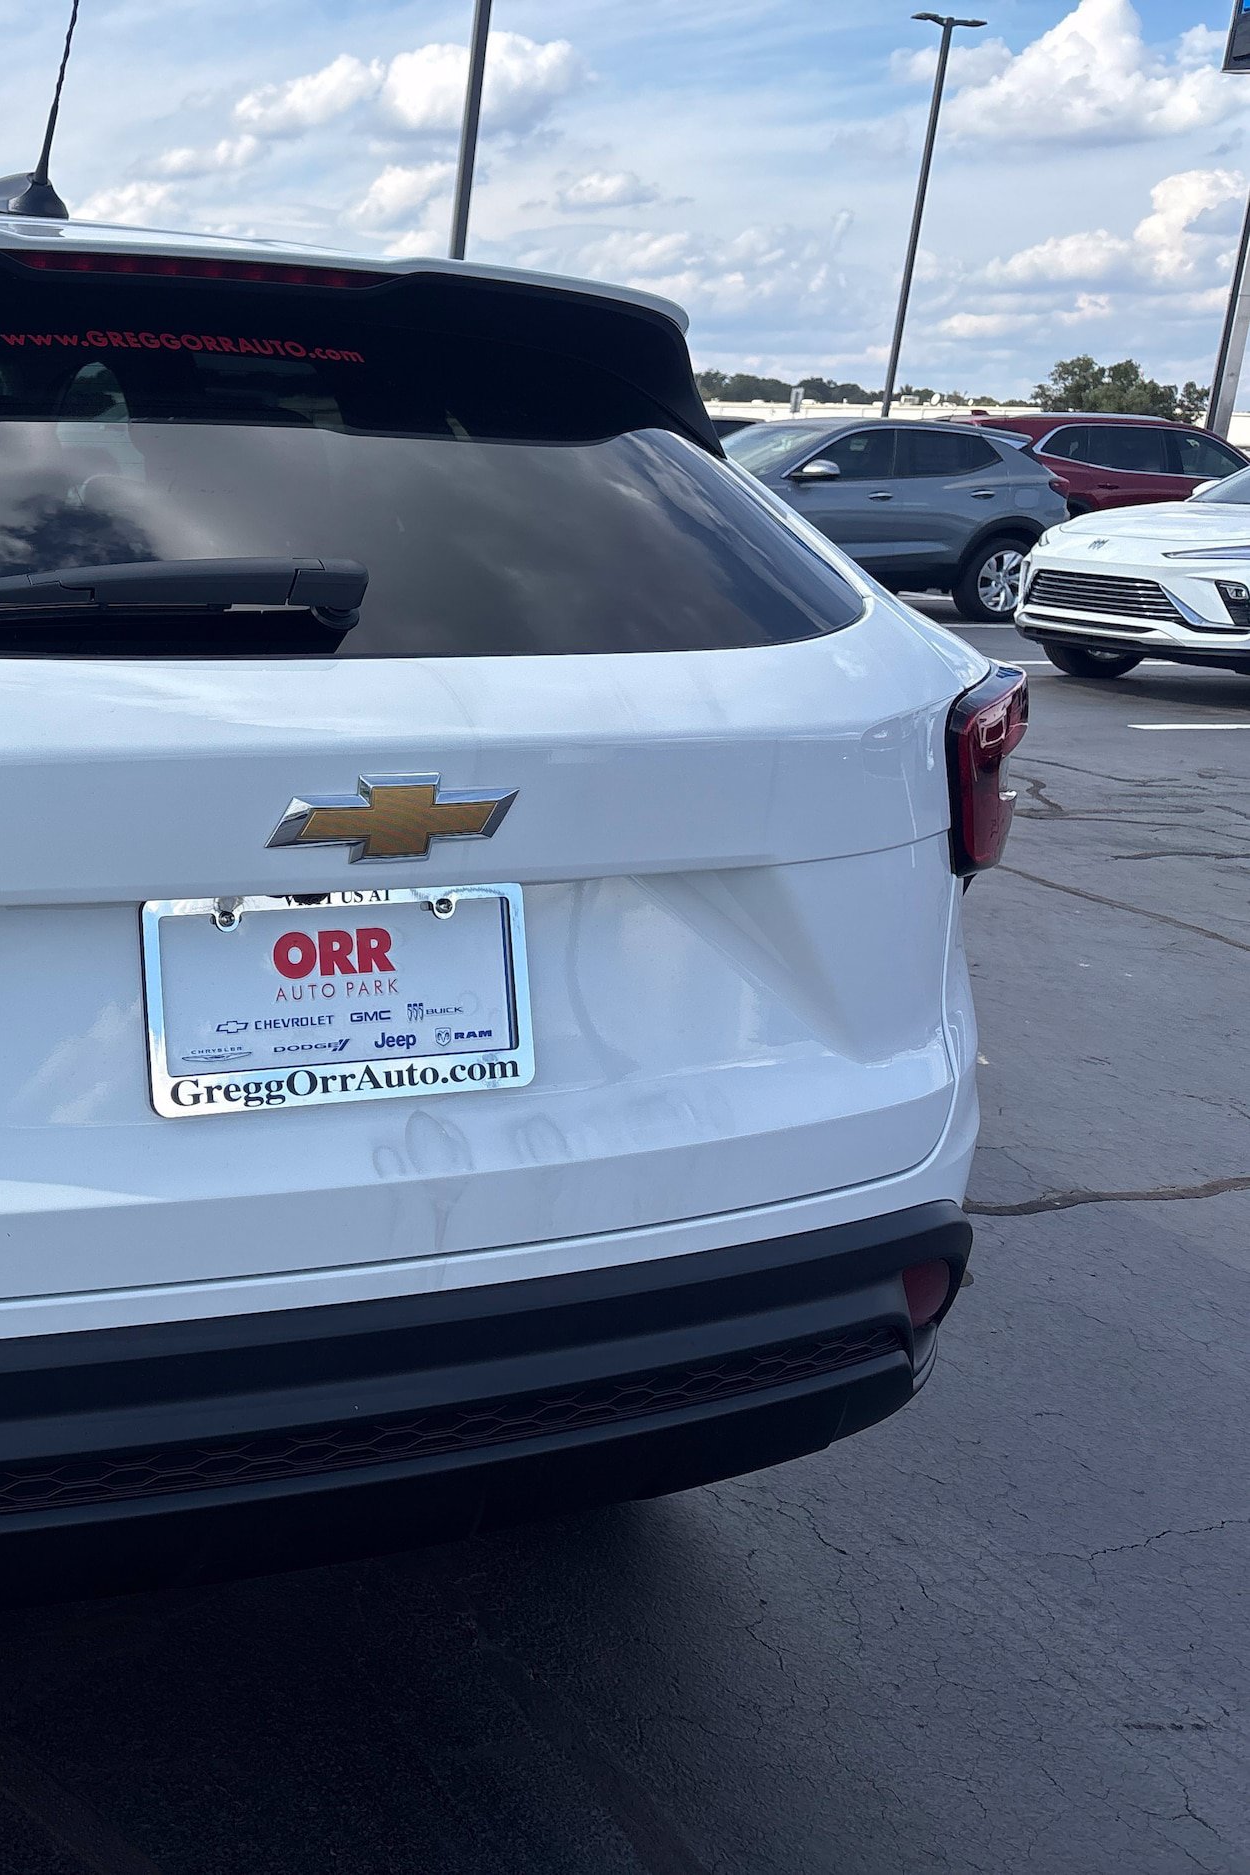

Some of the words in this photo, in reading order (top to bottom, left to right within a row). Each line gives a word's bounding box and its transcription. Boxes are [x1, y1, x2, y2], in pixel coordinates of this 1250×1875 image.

[0, 330, 365, 363] www.GREGGORRAUTO.com
[273, 927, 396, 979] ORR
[276, 983, 336, 1002] AUTO
[346, 979, 399, 997] PARK
[254, 1014, 335, 1031] CHEVROLET
[350, 1010, 392, 1023] GMC
[426, 1006, 464, 1015] BUICK
[190, 1046, 243, 1055] CHRYSLER
[273, 1041, 340, 1053] DODGE
[374, 1032, 417, 1050] Jeep
[454, 1029, 493, 1040] RAM
[170, 1059, 520, 1108] GreggOrrAuto.com
